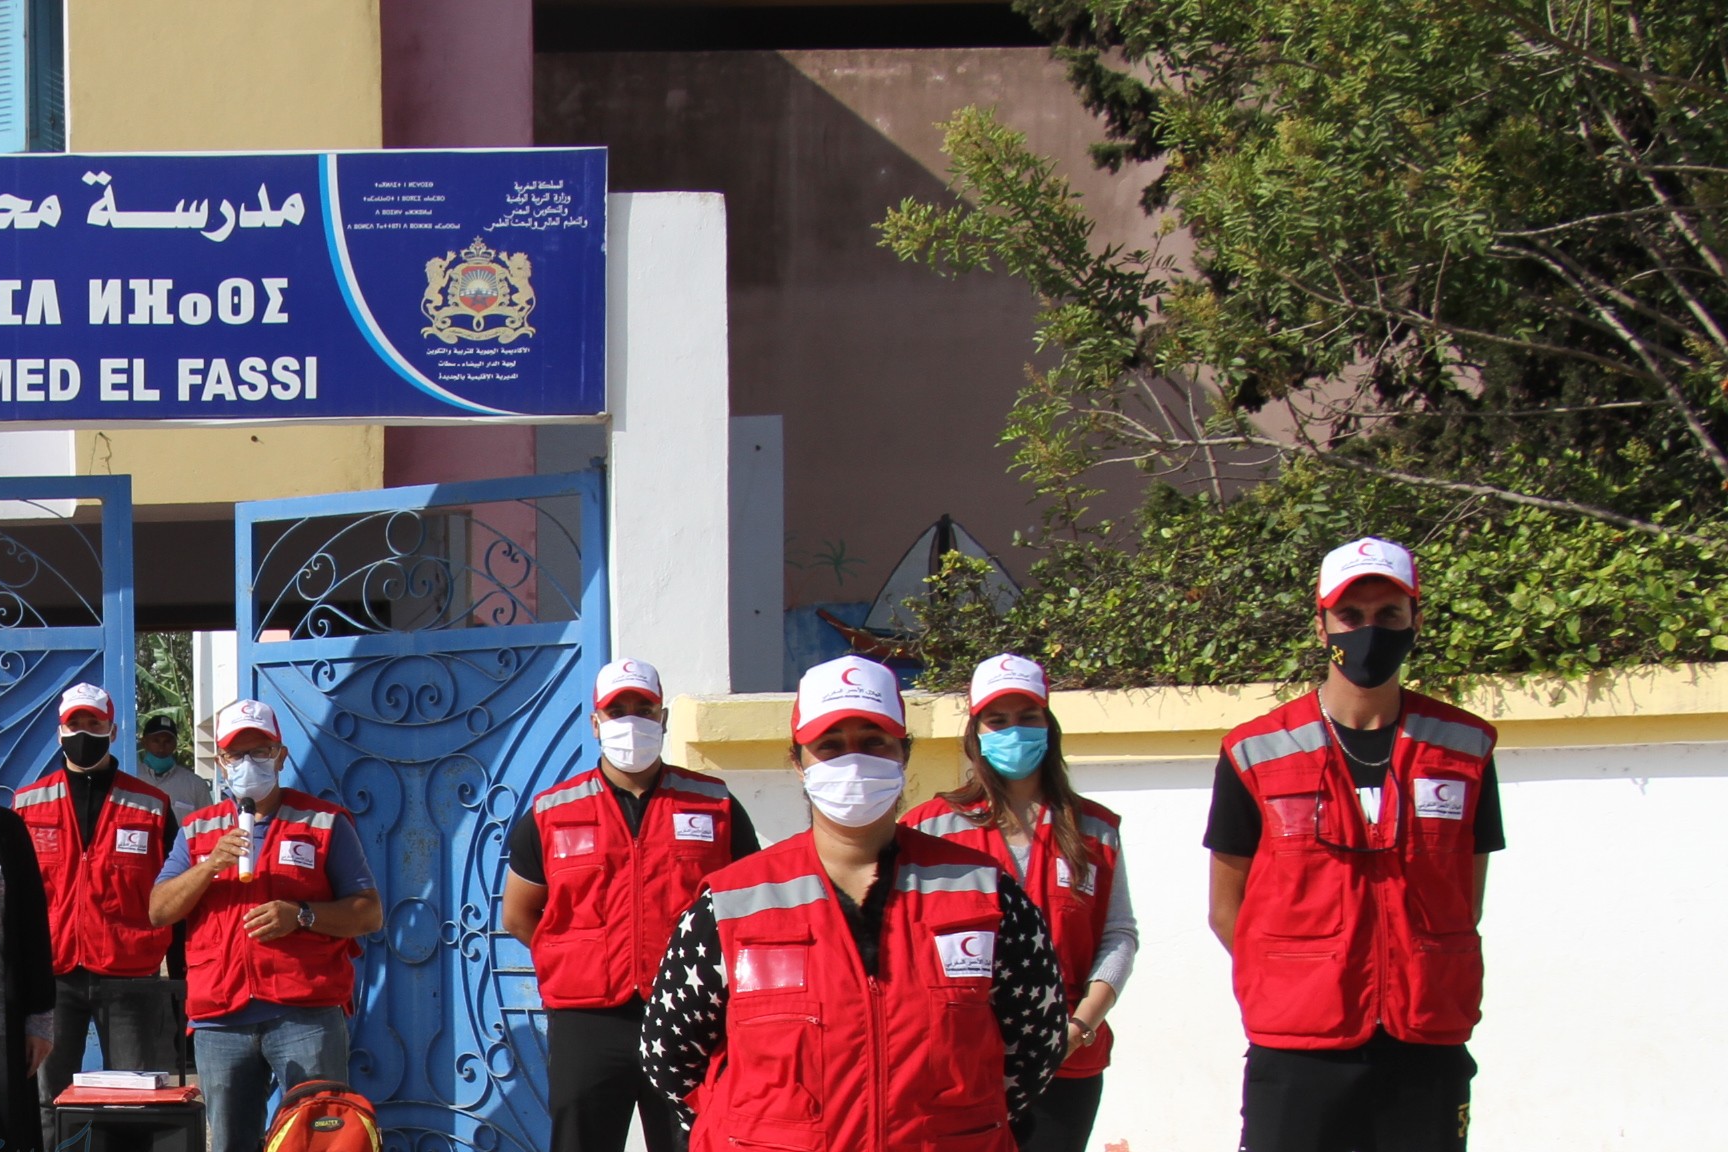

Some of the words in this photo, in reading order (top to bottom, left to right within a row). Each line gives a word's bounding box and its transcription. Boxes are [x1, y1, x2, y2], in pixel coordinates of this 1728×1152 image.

[81, 170, 306, 243] مدرسة
[88, 277, 289, 326] ⵍⴼⴰⵙⵉ
[100, 358, 161, 402] EL
[177, 356, 318, 401] FASSI
